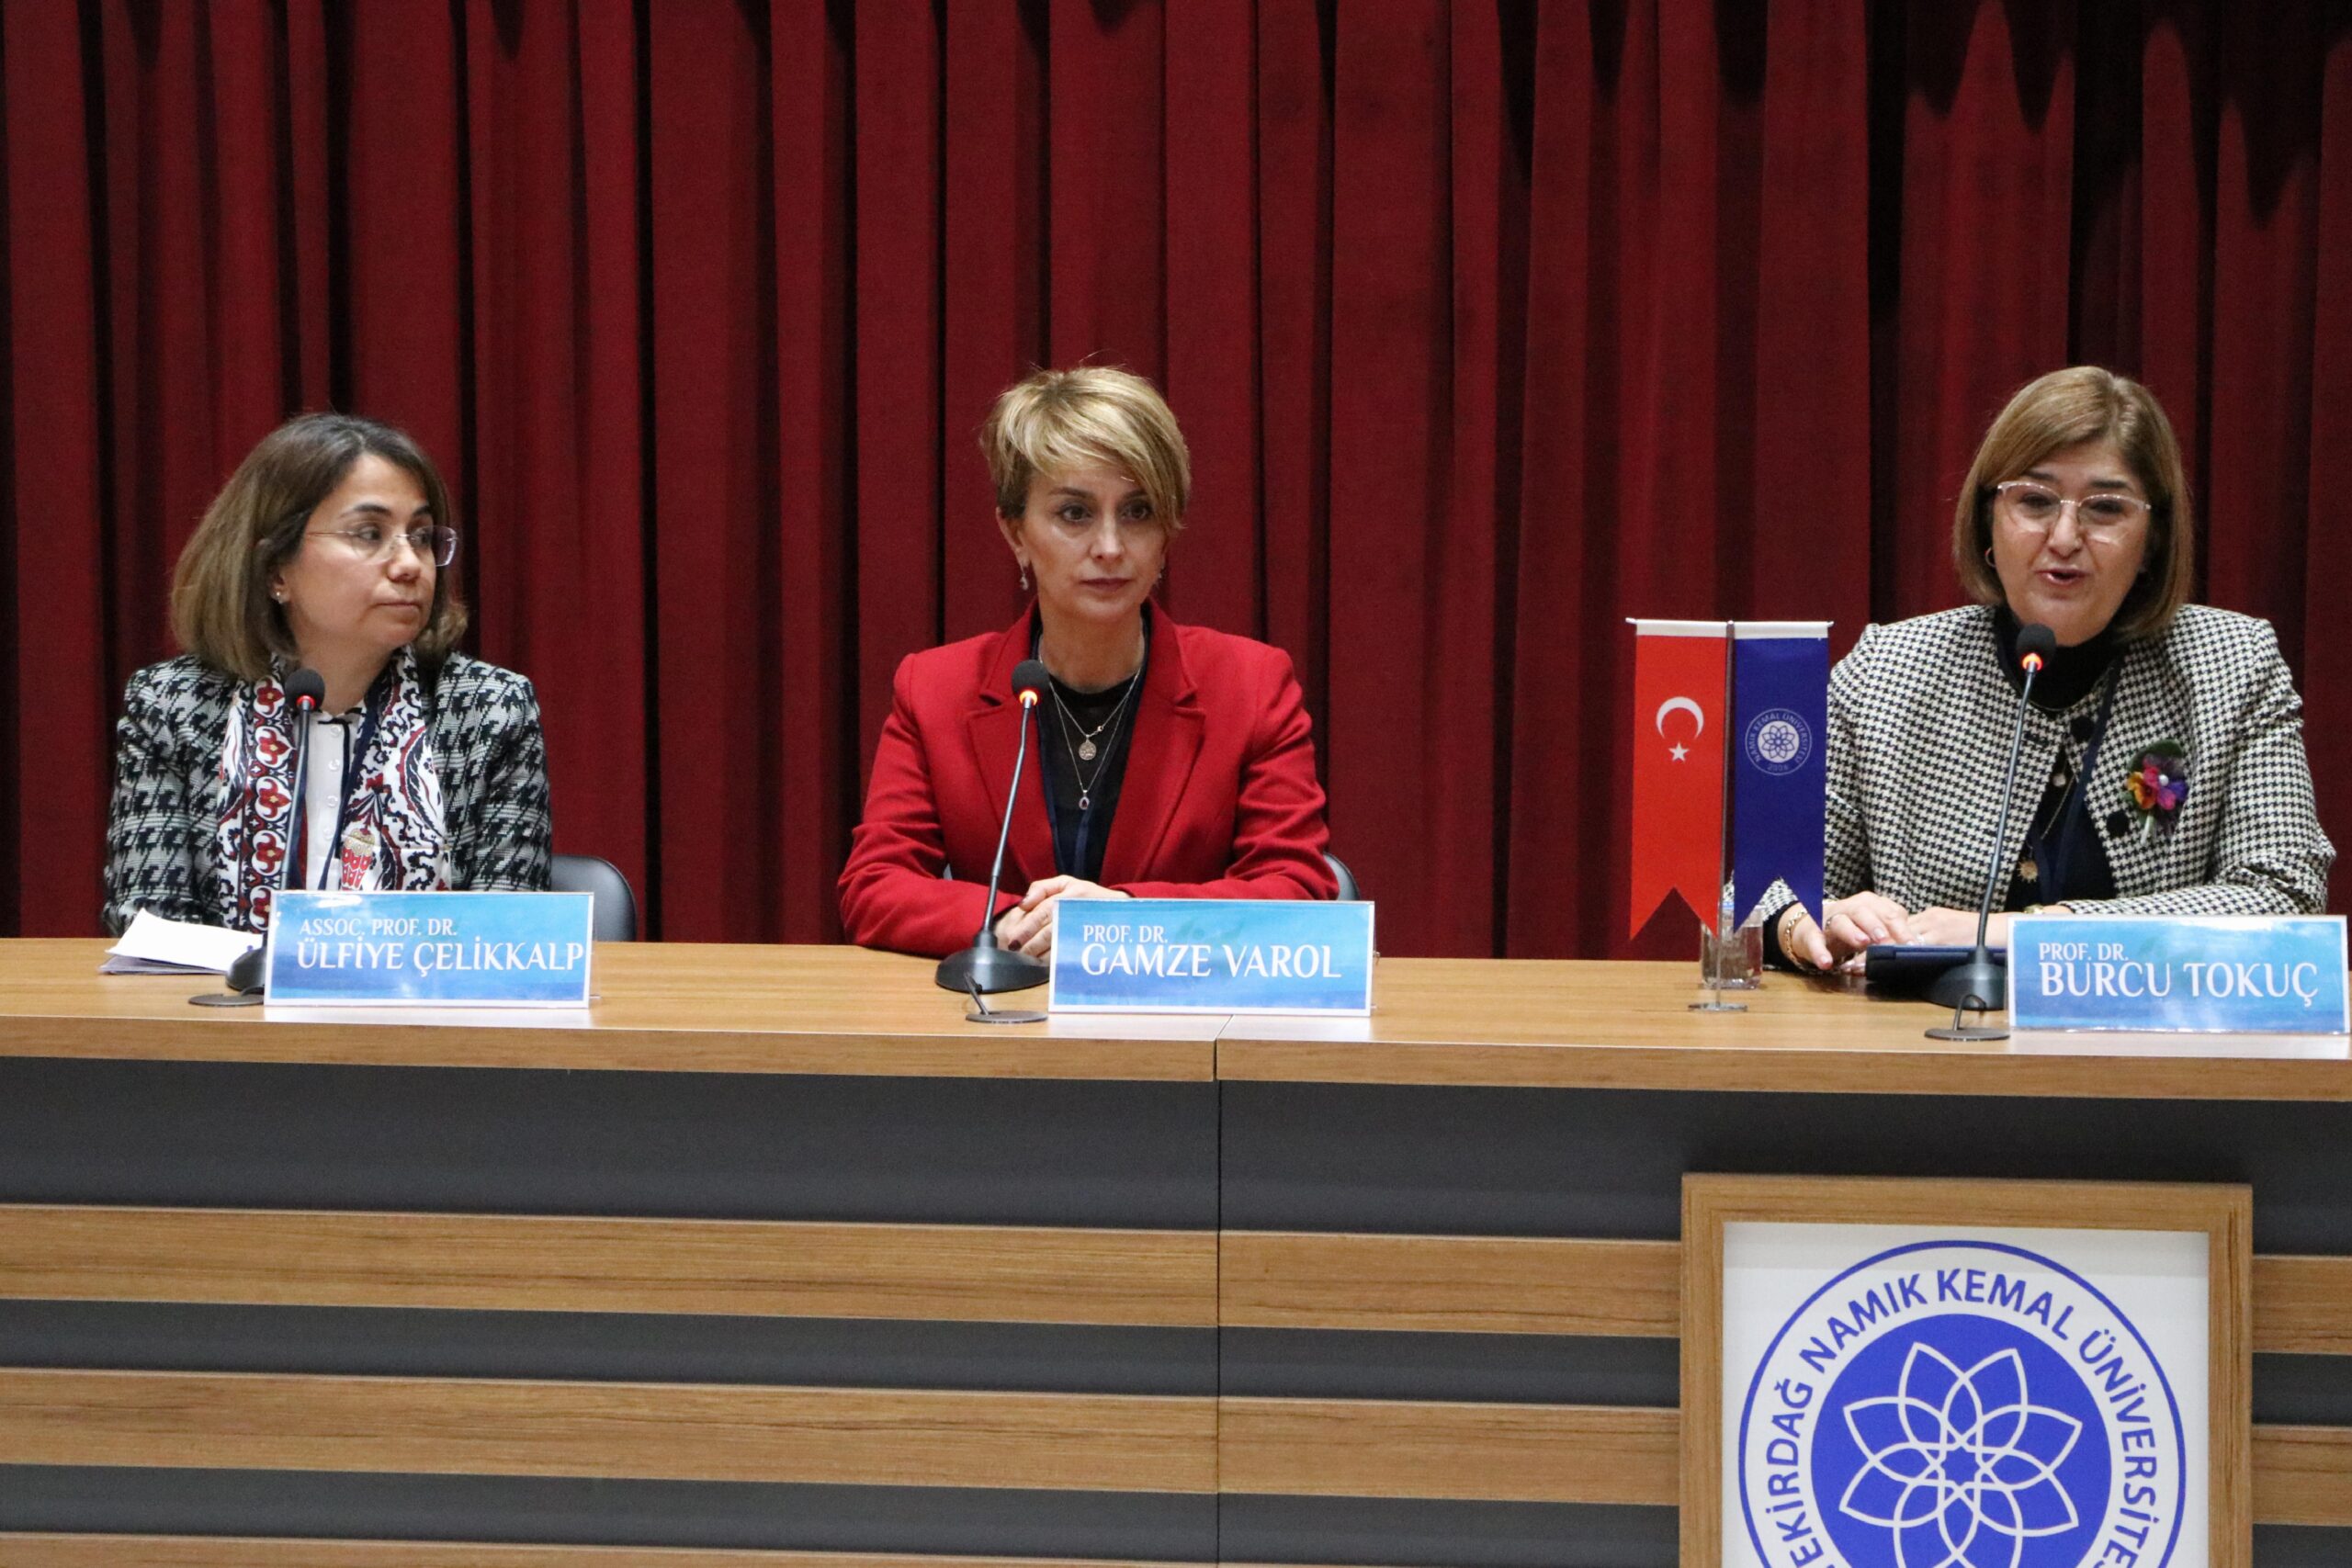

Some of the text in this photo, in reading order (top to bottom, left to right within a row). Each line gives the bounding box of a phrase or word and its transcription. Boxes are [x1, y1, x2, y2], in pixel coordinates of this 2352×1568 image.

[299, 918, 458, 937] ASSOC. PROF. DR.
[1082, 924, 1169, 943] PROF. DR.
[297, 935, 584, 977] ÜLFİYE ÇELİKKALP
[1080, 942, 1342, 978] GAMZE VAROL
[2038, 942, 2129, 961] PROF. DR.
[2038, 961, 2319, 1008] BURCU TOKUÇ
[1765, 1269, 2160, 1568] EKİRDAĞ NAMIK KEMAL ÜNİVERSİTE
